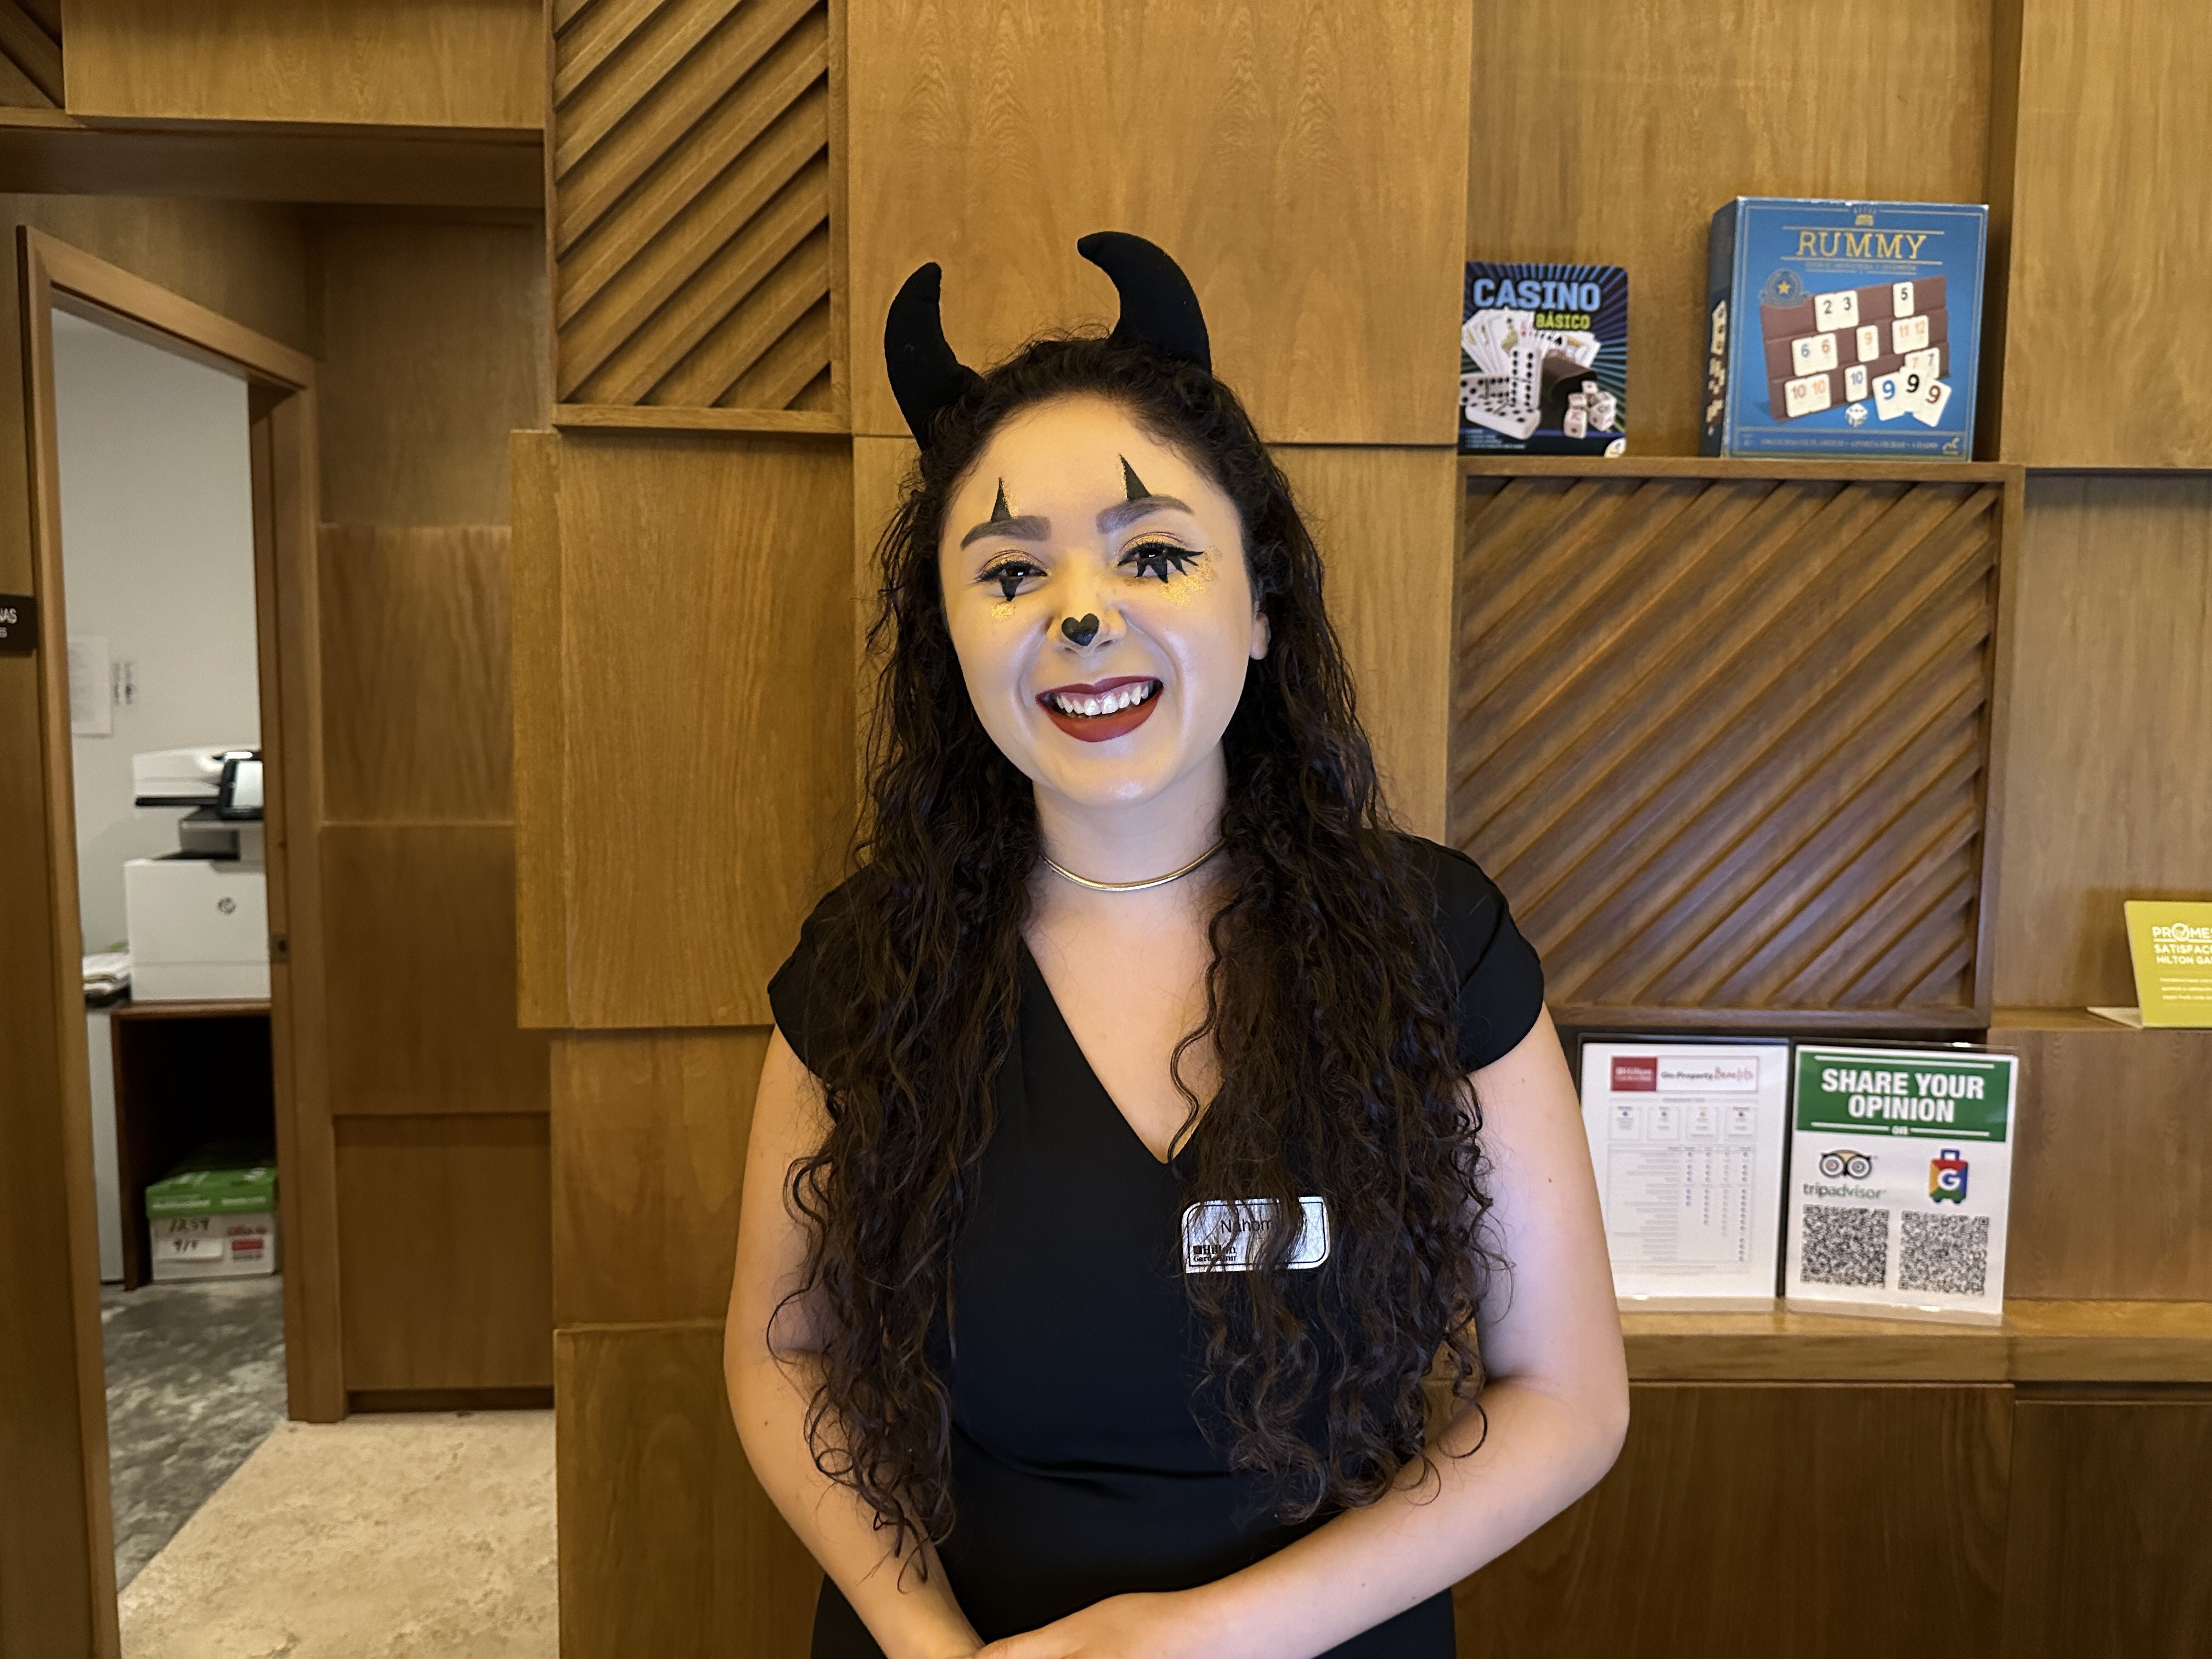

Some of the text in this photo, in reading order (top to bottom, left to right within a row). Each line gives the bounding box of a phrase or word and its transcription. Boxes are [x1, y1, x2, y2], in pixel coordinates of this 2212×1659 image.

[1796, 230, 1927, 259] RUMMY
[1472, 278, 1601, 312] CASINO
[1900, 287, 1909, 301] 5
[1823, 296, 1851, 315] 2 3
[1536, 311, 1590, 330] BÁSICO
[1899, 324, 1910, 337] 11
[1801, 338, 1830, 358] 6 6
[1851, 370, 1864, 385] 10
[1791, 383, 1807, 399] 10
[1882, 374, 1942, 404] 9 9 9
[2154, 944, 2212, 955] SATISFAC
[2156, 955, 2212, 964] HILTON GA
[1821, 1068, 1984, 1099] SHARE YOUR
[1848, 1096, 1955, 1123] OPINION
[1937, 1167, 1961, 1191] G
[1803, 1183, 1882, 1200] tripadvisor
[1221, 1218, 1272, 1234] Nhom
